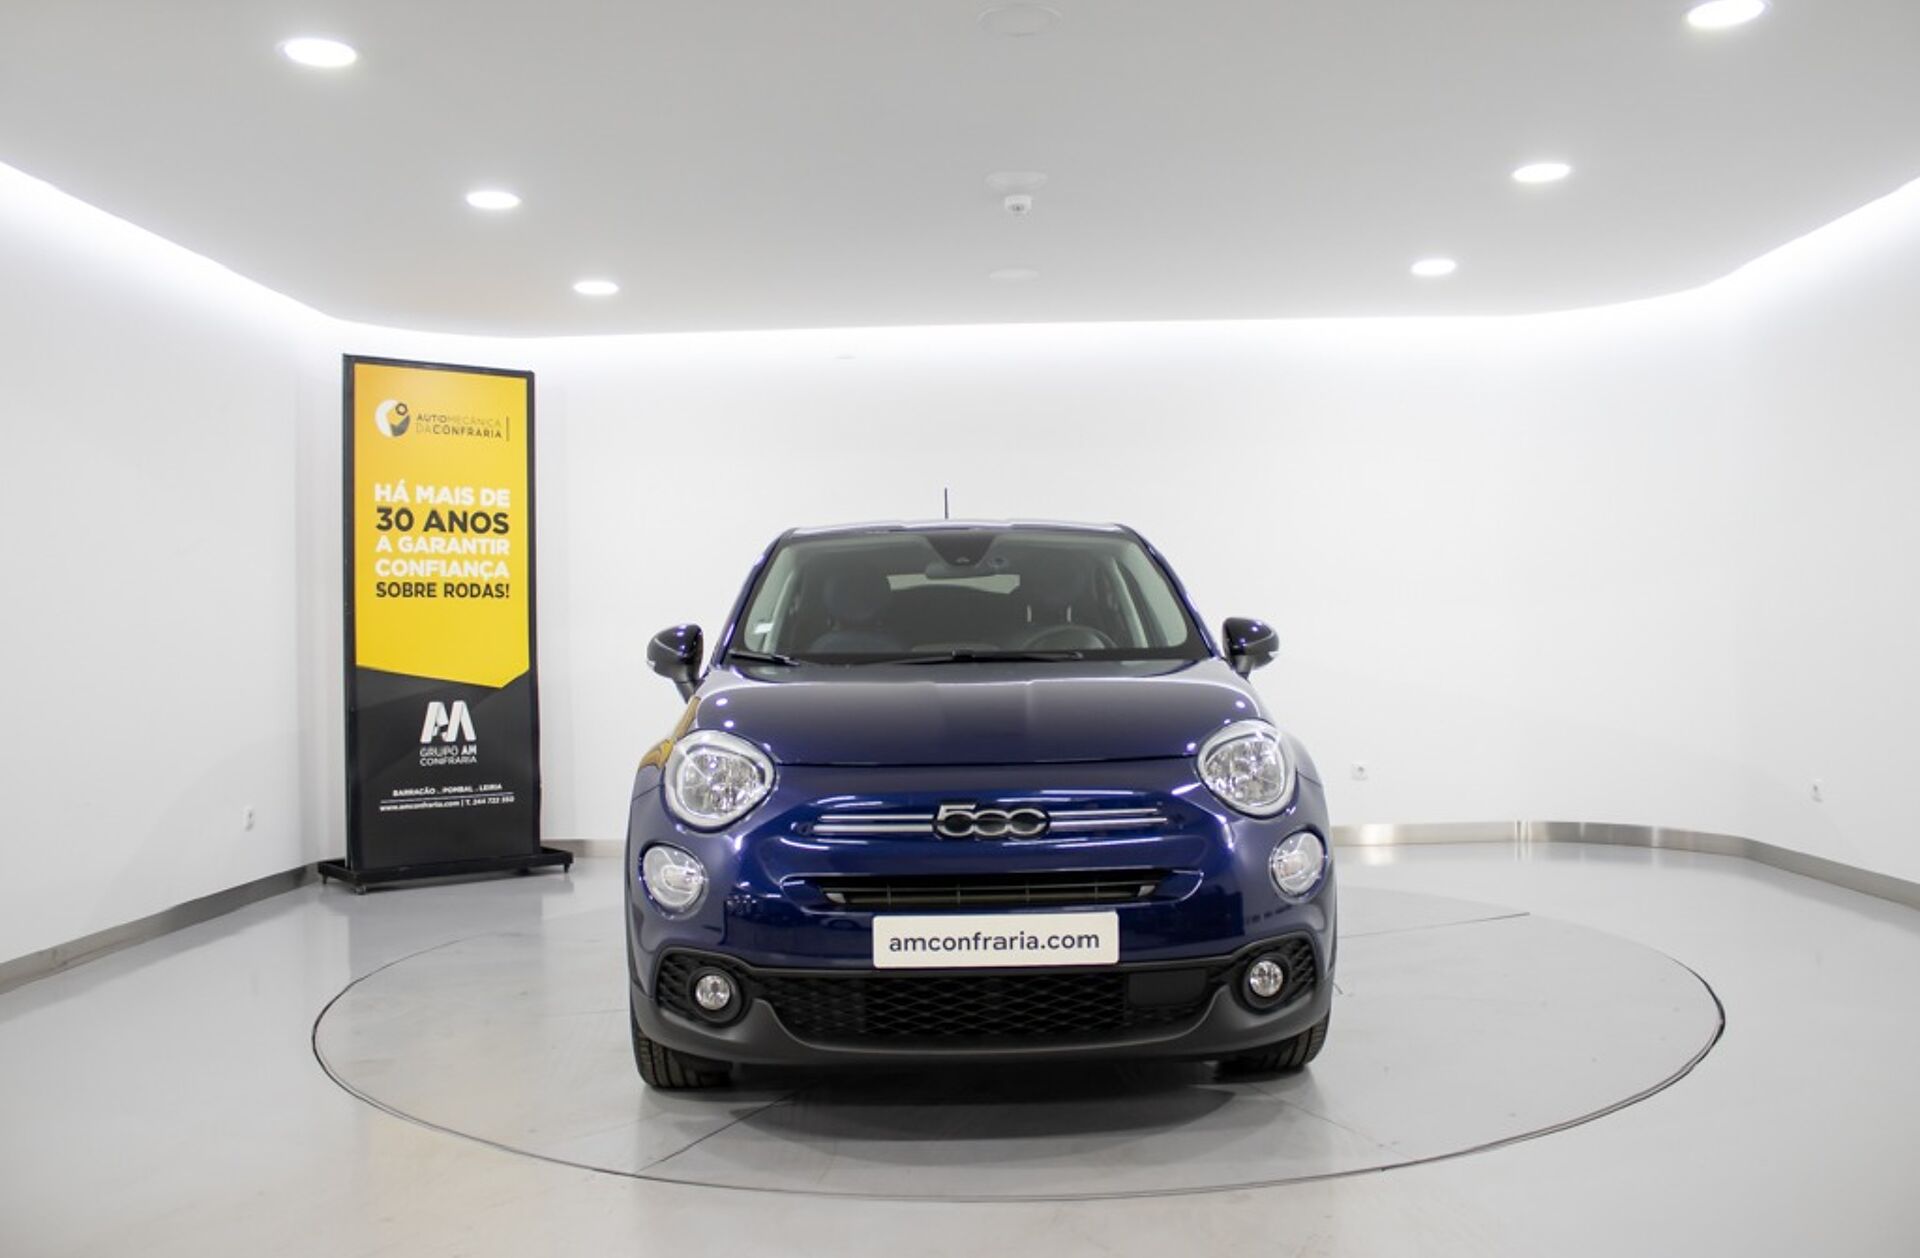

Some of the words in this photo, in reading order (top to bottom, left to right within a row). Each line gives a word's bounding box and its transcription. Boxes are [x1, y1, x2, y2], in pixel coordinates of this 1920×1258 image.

[374, 479, 409, 503] HÁ
[415, 484, 474, 506] MAIS
[480, 488, 511, 508] DE
[375, 507, 414, 532] 30
[422, 509, 510, 534] ANOS
[375, 535, 392, 553] A
[397, 536, 510, 556] GARANTIR
[375, 558, 510, 581] CONFIANÇA
[376, 582, 437, 598] SOBRE
[444, 583, 510, 599] RODAS!
[420, 745, 459, 758] GRUPO
[461, 744, 478, 756] AM
[420, 756, 478, 767] CONFRARIA
[936, 803, 1047, 836] 500
[889, 931, 1100, 952] amconfraria.com
